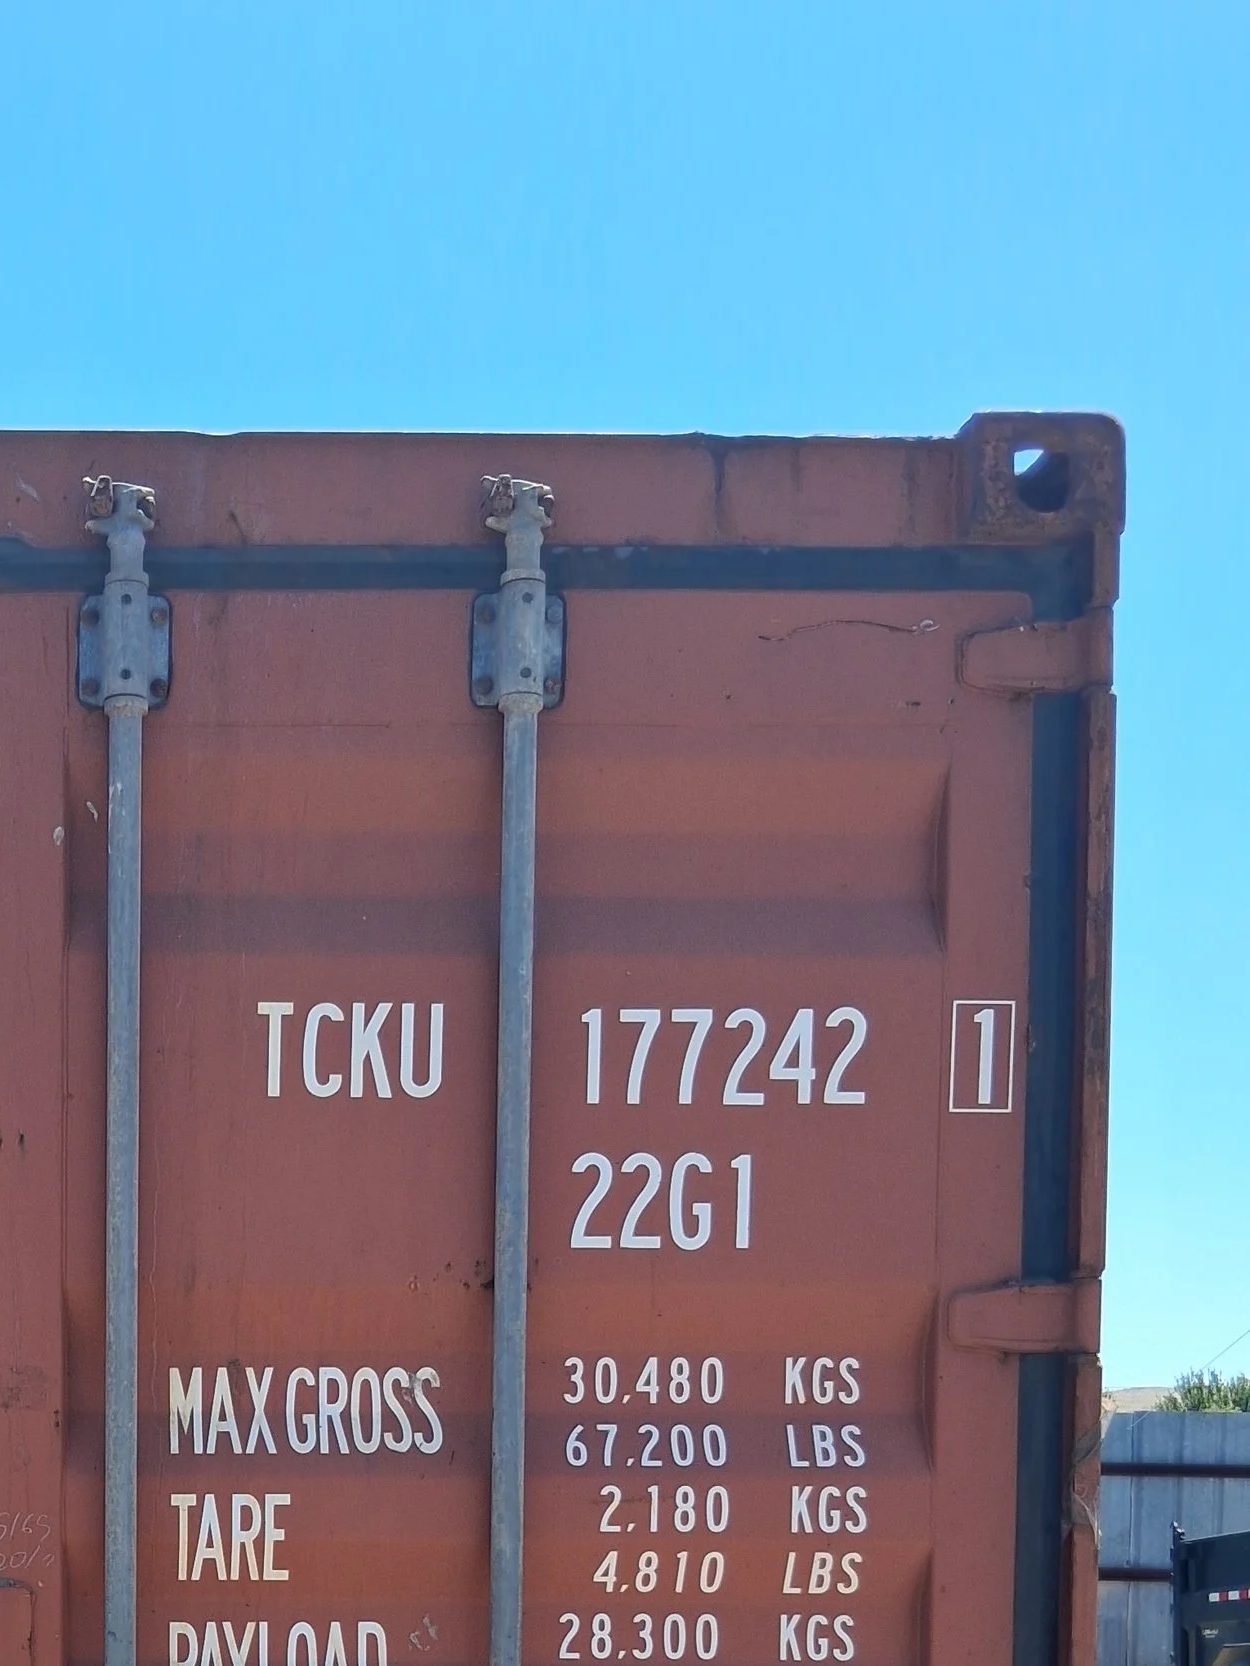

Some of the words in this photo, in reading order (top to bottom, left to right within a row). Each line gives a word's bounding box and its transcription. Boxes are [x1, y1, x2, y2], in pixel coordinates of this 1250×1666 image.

[257, 1002, 444, 1099] TCKU
[581, 1006, 868, 1106] 177242
[972, 1008, 995, 1105] 1
[570, 1152, 752, 1250] 22G1
[168, 1366, 278, 1454] MAX
[285, 1366, 444, 1454] GROSS
[563, 1356, 724, 1404] 30,480
[784, 1357, 861, 1405] KGS
[565, 1424, 727, 1467] 67,200
[788, 1424, 866, 1468] LBS
[170, 1493, 292, 1582] TARE
[599, 1485, 729, 1533] 2,180
[790, 1485, 869, 1534] KGS
[593, 1550, 725, 1593] 4,810
[783, 1551, 863, 1595] LBS
[558, 1612, 719, 1661] 28,300
[779, 1613, 855, 1662] KGS
